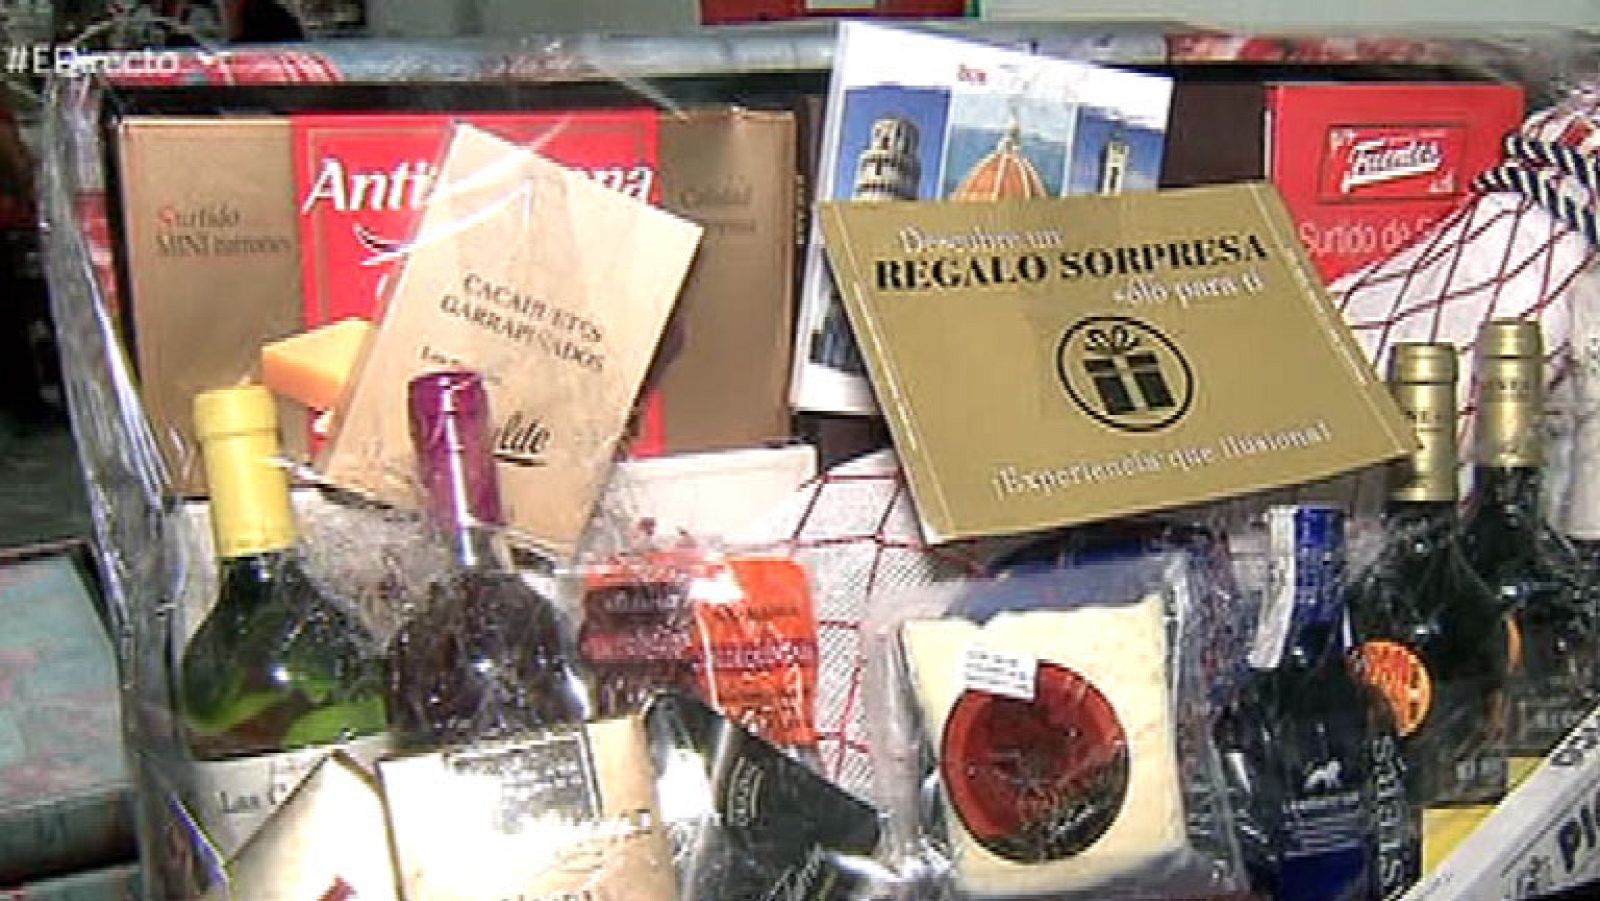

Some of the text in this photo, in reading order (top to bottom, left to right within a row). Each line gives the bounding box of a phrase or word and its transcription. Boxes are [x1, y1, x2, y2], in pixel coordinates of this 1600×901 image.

[154, 235, 210, 258] MINI
[1300, 216, 1376, 255] Surtido
[1381, 216, 1412, 250] de
[875, 233, 1268, 291] REGALO SORPRESA
[1174, 274, 1240, 309] para
